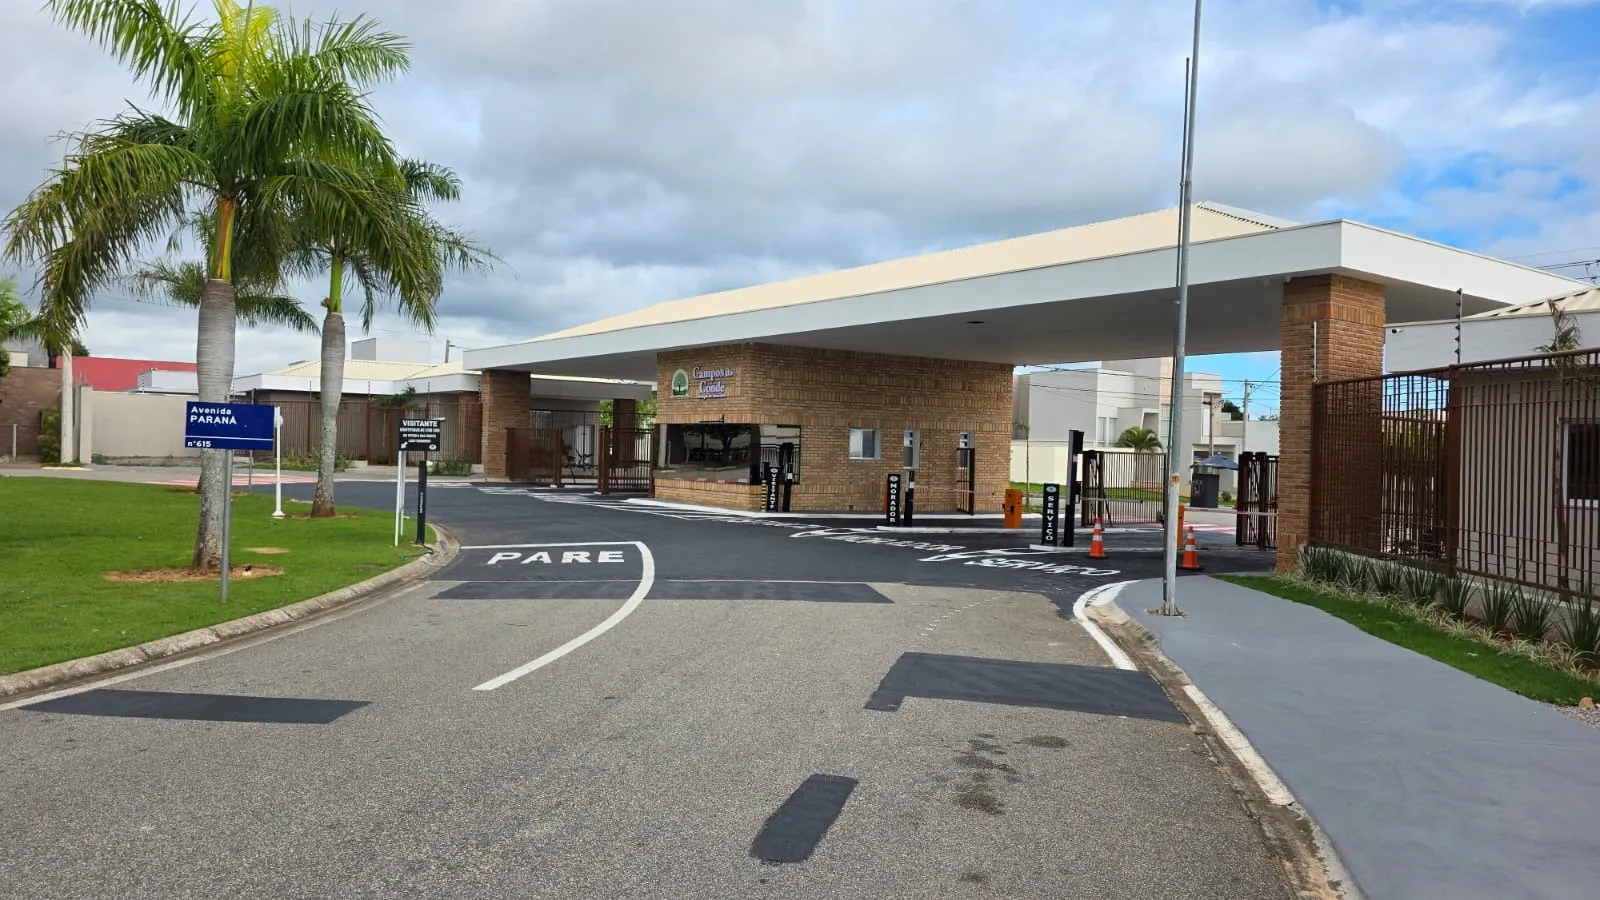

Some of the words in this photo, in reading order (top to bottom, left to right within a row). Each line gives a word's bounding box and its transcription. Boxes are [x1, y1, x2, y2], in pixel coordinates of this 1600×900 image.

[693, 367, 724, 381] Campos
[700, 381, 725, 393] Conde
[190, 405, 232, 415] Avenida
[402, 419, 438, 427] VISITANTE
[769, 473, 777, 509] VISITANTE
[889, 483, 897, 523] MORADOR
[1045, 495, 1055, 541] SERVIÇO
[487, 552, 624, 564] PARE
